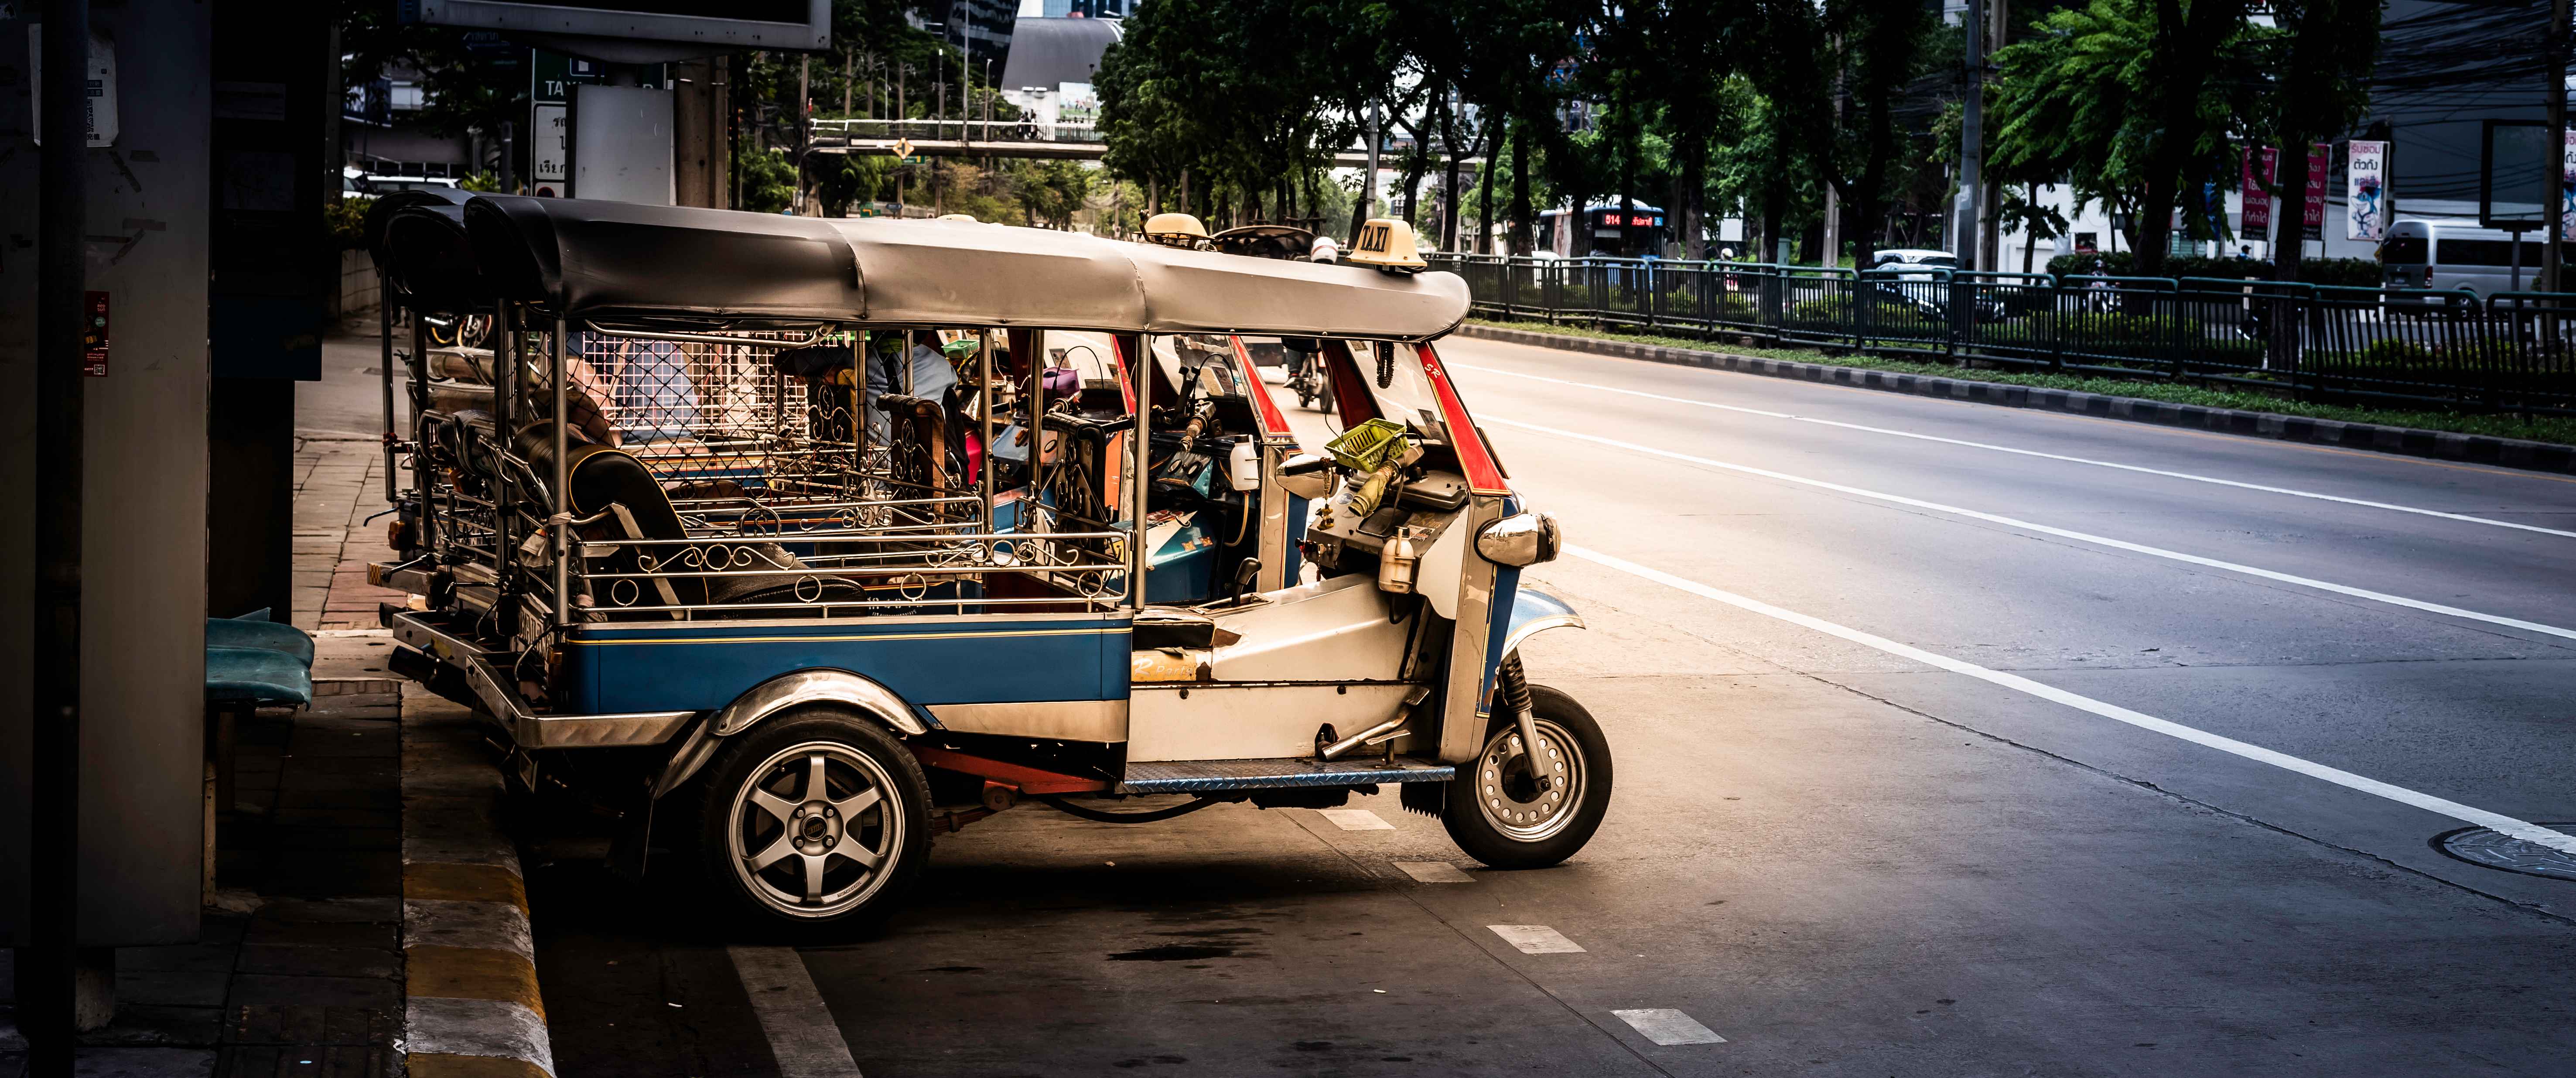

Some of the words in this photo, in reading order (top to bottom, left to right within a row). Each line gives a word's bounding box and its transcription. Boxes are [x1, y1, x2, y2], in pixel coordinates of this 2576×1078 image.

[1605, 214, 1620, 225] 514
[1360, 225, 1389, 252] TAXI
[1425, 363, 1441, 379] SR
